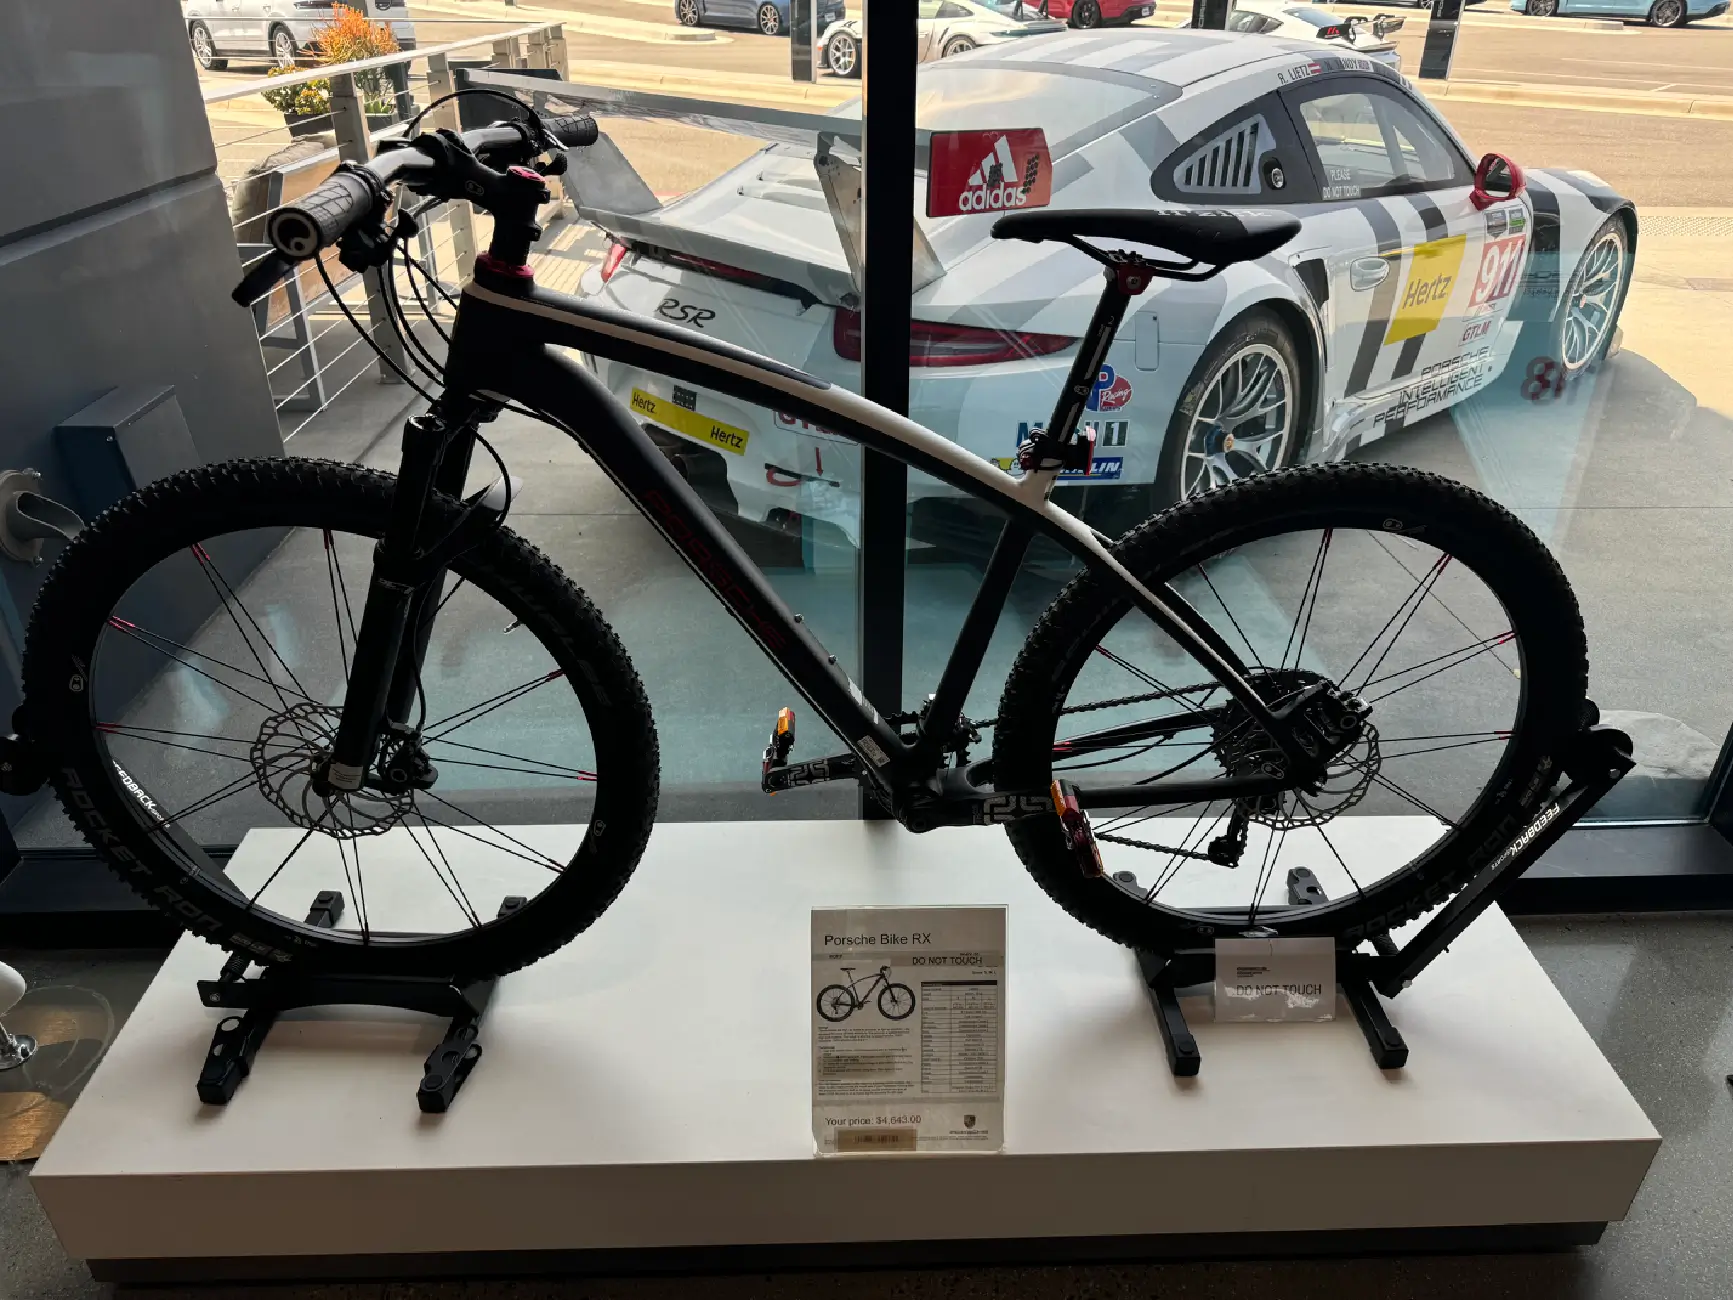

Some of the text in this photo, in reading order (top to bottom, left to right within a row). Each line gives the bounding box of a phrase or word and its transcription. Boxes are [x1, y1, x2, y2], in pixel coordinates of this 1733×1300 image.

[1330, 168, 1351, 180] PLEASE
[959, 182, 1026, 211] adidas
[1323, 185, 1360, 198] DO NOT TOUCH
[1476, 237, 1525, 301] 911
[1402, 273, 1453, 310] Hertz
[656, 298, 716, 328] RSR
[1462, 321, 1492, 342] GTLM
[1421, 345, 1490, 379] PORSCHE
[1400, 363, 1483, 402] INTELLIGENT
[1101, 389, 1131, 407] Racing
[1373, 373, 1483, 428] PERFORMANCE
[631, 391, 656, 414] Hertz
[710, 424, 743, 448] Hertz
[638, 489, 787, 650] PORSCHE
[1510, 802, 1560, 857] FEEDBACK
[61, 766, 224, 932] ROCKET RON
[824, 932, 931, 946] Porsche Bike RX
[912, 956, 983, 965] DO NOT TOUCH
[1236, 984, 1322, 995] DO NOT TOUCH
[824, 1117, 847, 1126] Your
[849, 1116, 873, 1127] price:
